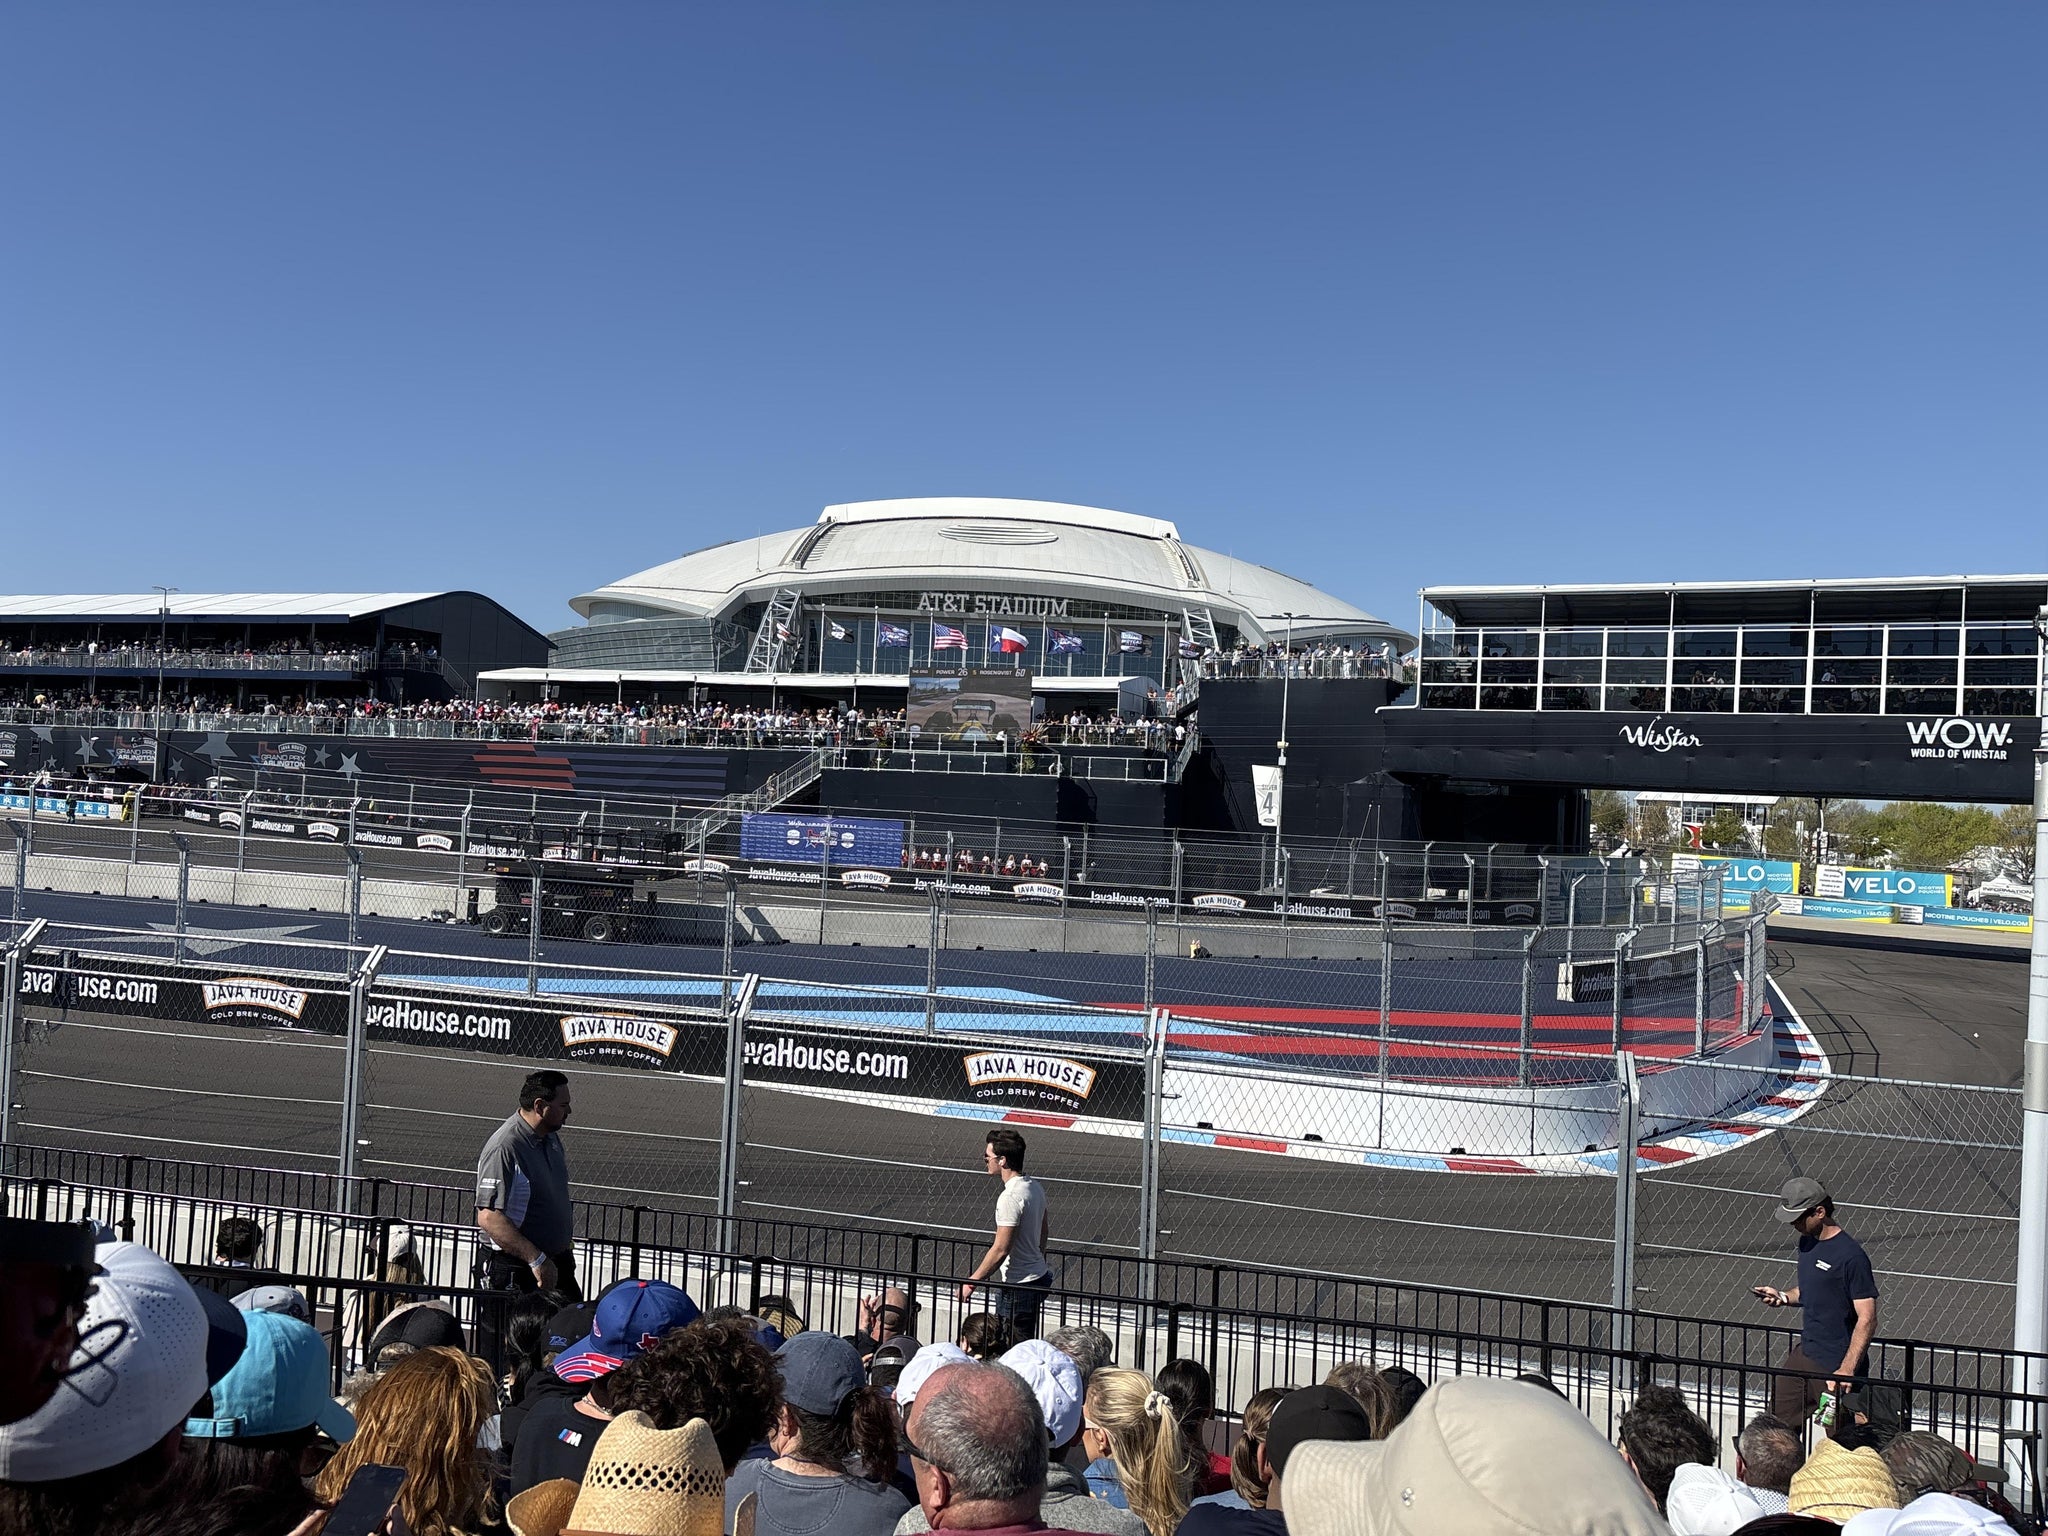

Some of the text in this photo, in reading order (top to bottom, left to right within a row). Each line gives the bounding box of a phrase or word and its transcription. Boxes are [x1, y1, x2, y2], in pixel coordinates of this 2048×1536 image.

[917, 592, 1071, 617] AT&T STADIUM
[957, 668, 969, 677] 26
[1015, 668, 1026, 677] 60
[1618, 718, 1704, 752] WinStar
[288, 754, 306, 762] PRIX
[1910, 748, 2008, 760] WORLD OF WINSTAR
[1263, 791, 1273, 815] 4
[355, 831, 403, 846] avaHouse.com
[1846, 877, 1916, 894] VELO
[1982, 886, 2032, 895] INFORMATION
[1196, 897, 1243, 908] JAVA HOUSE
[1273, 901, 1351, 918] JaaHouse.com
[1803, 904, 1832, 913] NICOTINE
[1832, 907, 1862, 915] POUCHES
[1433, 907, 1490, 920] JavaHous.com
[1924, 912, 1956, 920] NICOTINE
[1956, 915, 1989, 923] POUCHES
[1992, 919, 2029, 927] VELO.COM
[20, 970, 158, 1004] avause.com
[211, 985, 298, 1009] JAVA HOUSE
[211, 1010, 294, 1028] COLD BREW COFFEE
[570, 1019, 668, 1046] JAVA HOUSE
[570, 1047, 663, 1066] COLD BREW COFFEE
[976, 1057, 1085, 1088] JAVA HOUSE
[976, 1088, 1080, 1110] COLD BREW COFFEE
